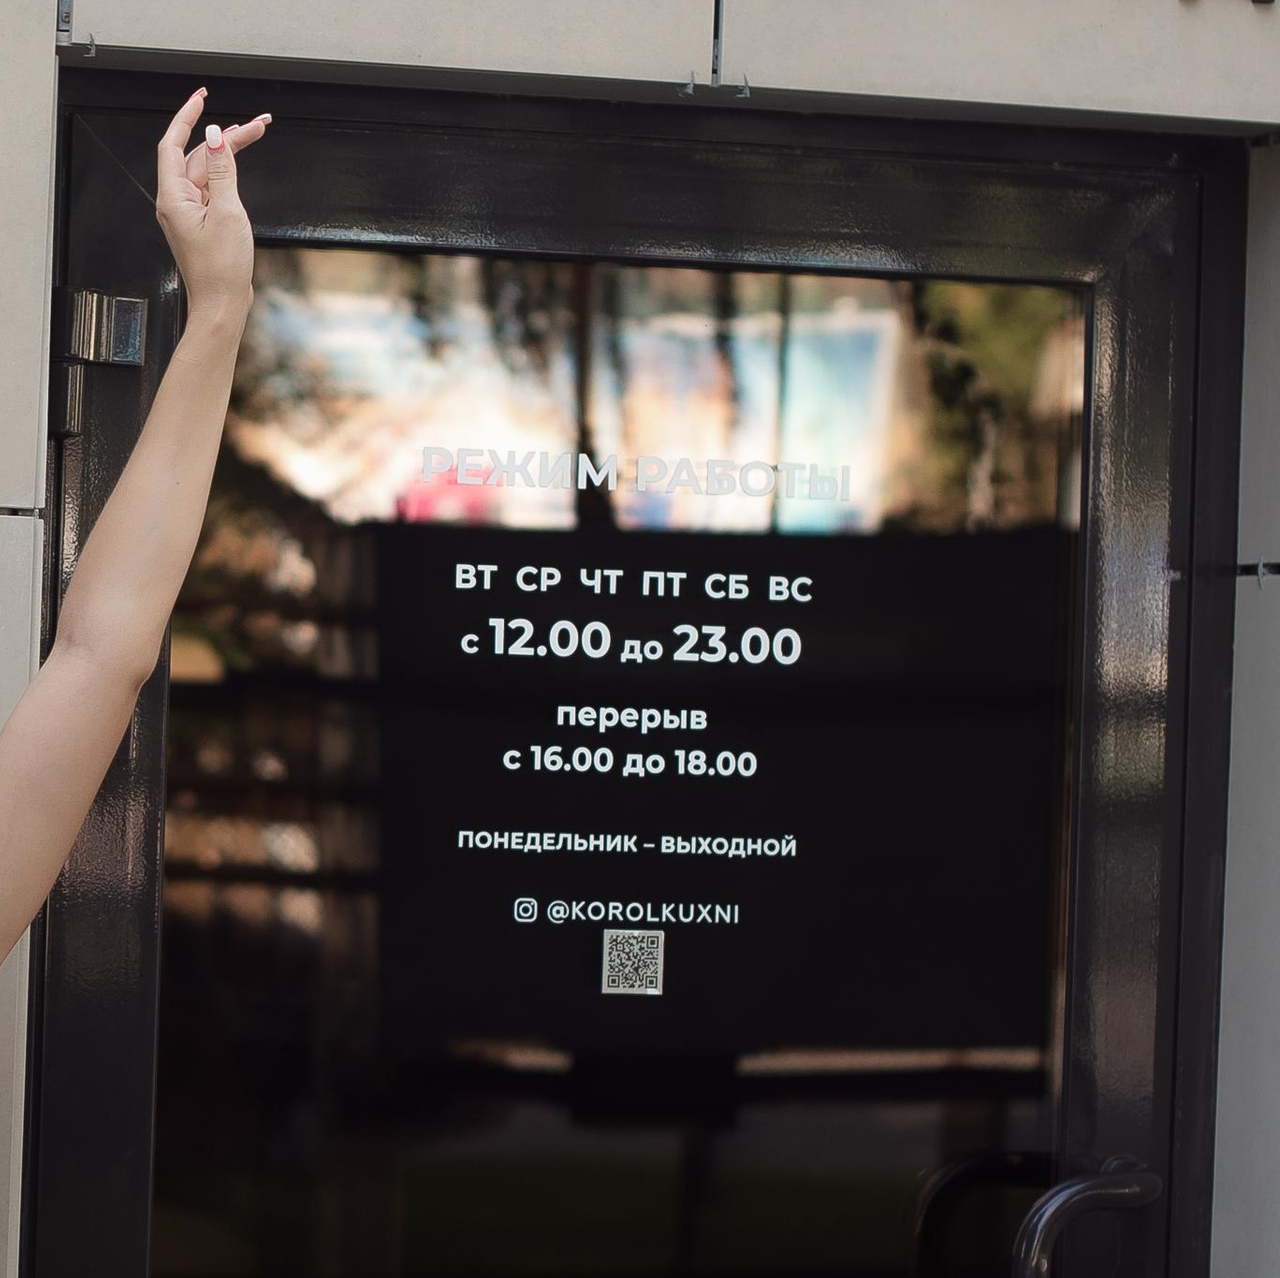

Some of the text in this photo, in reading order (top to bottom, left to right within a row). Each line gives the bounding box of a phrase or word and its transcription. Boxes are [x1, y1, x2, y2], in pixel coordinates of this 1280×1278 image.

[421, 445, 852, 502] РЕЖИМ РАБОТЫ
[454, 563, 814, 603] ВТ СР ЧТ ПТ СБ ВС
[488, 617, 612, 659] 12.00
[620, 639, 664, 664] до
[672, 624, 802, 665] 23.00
[557, 705, 708, 735] перерыв
[529, 745, 614, 773] 16.00
[622, 753, 666, 778] до
[673, 749, 758, 777] 18.00
[457, 830, 639, 855] ПОНЕДЕЛЬНИК
[660, 833, 798, 859] ВЫХОДНОЙ
[546, 899, 740, 925] @KOROLKUXNI
